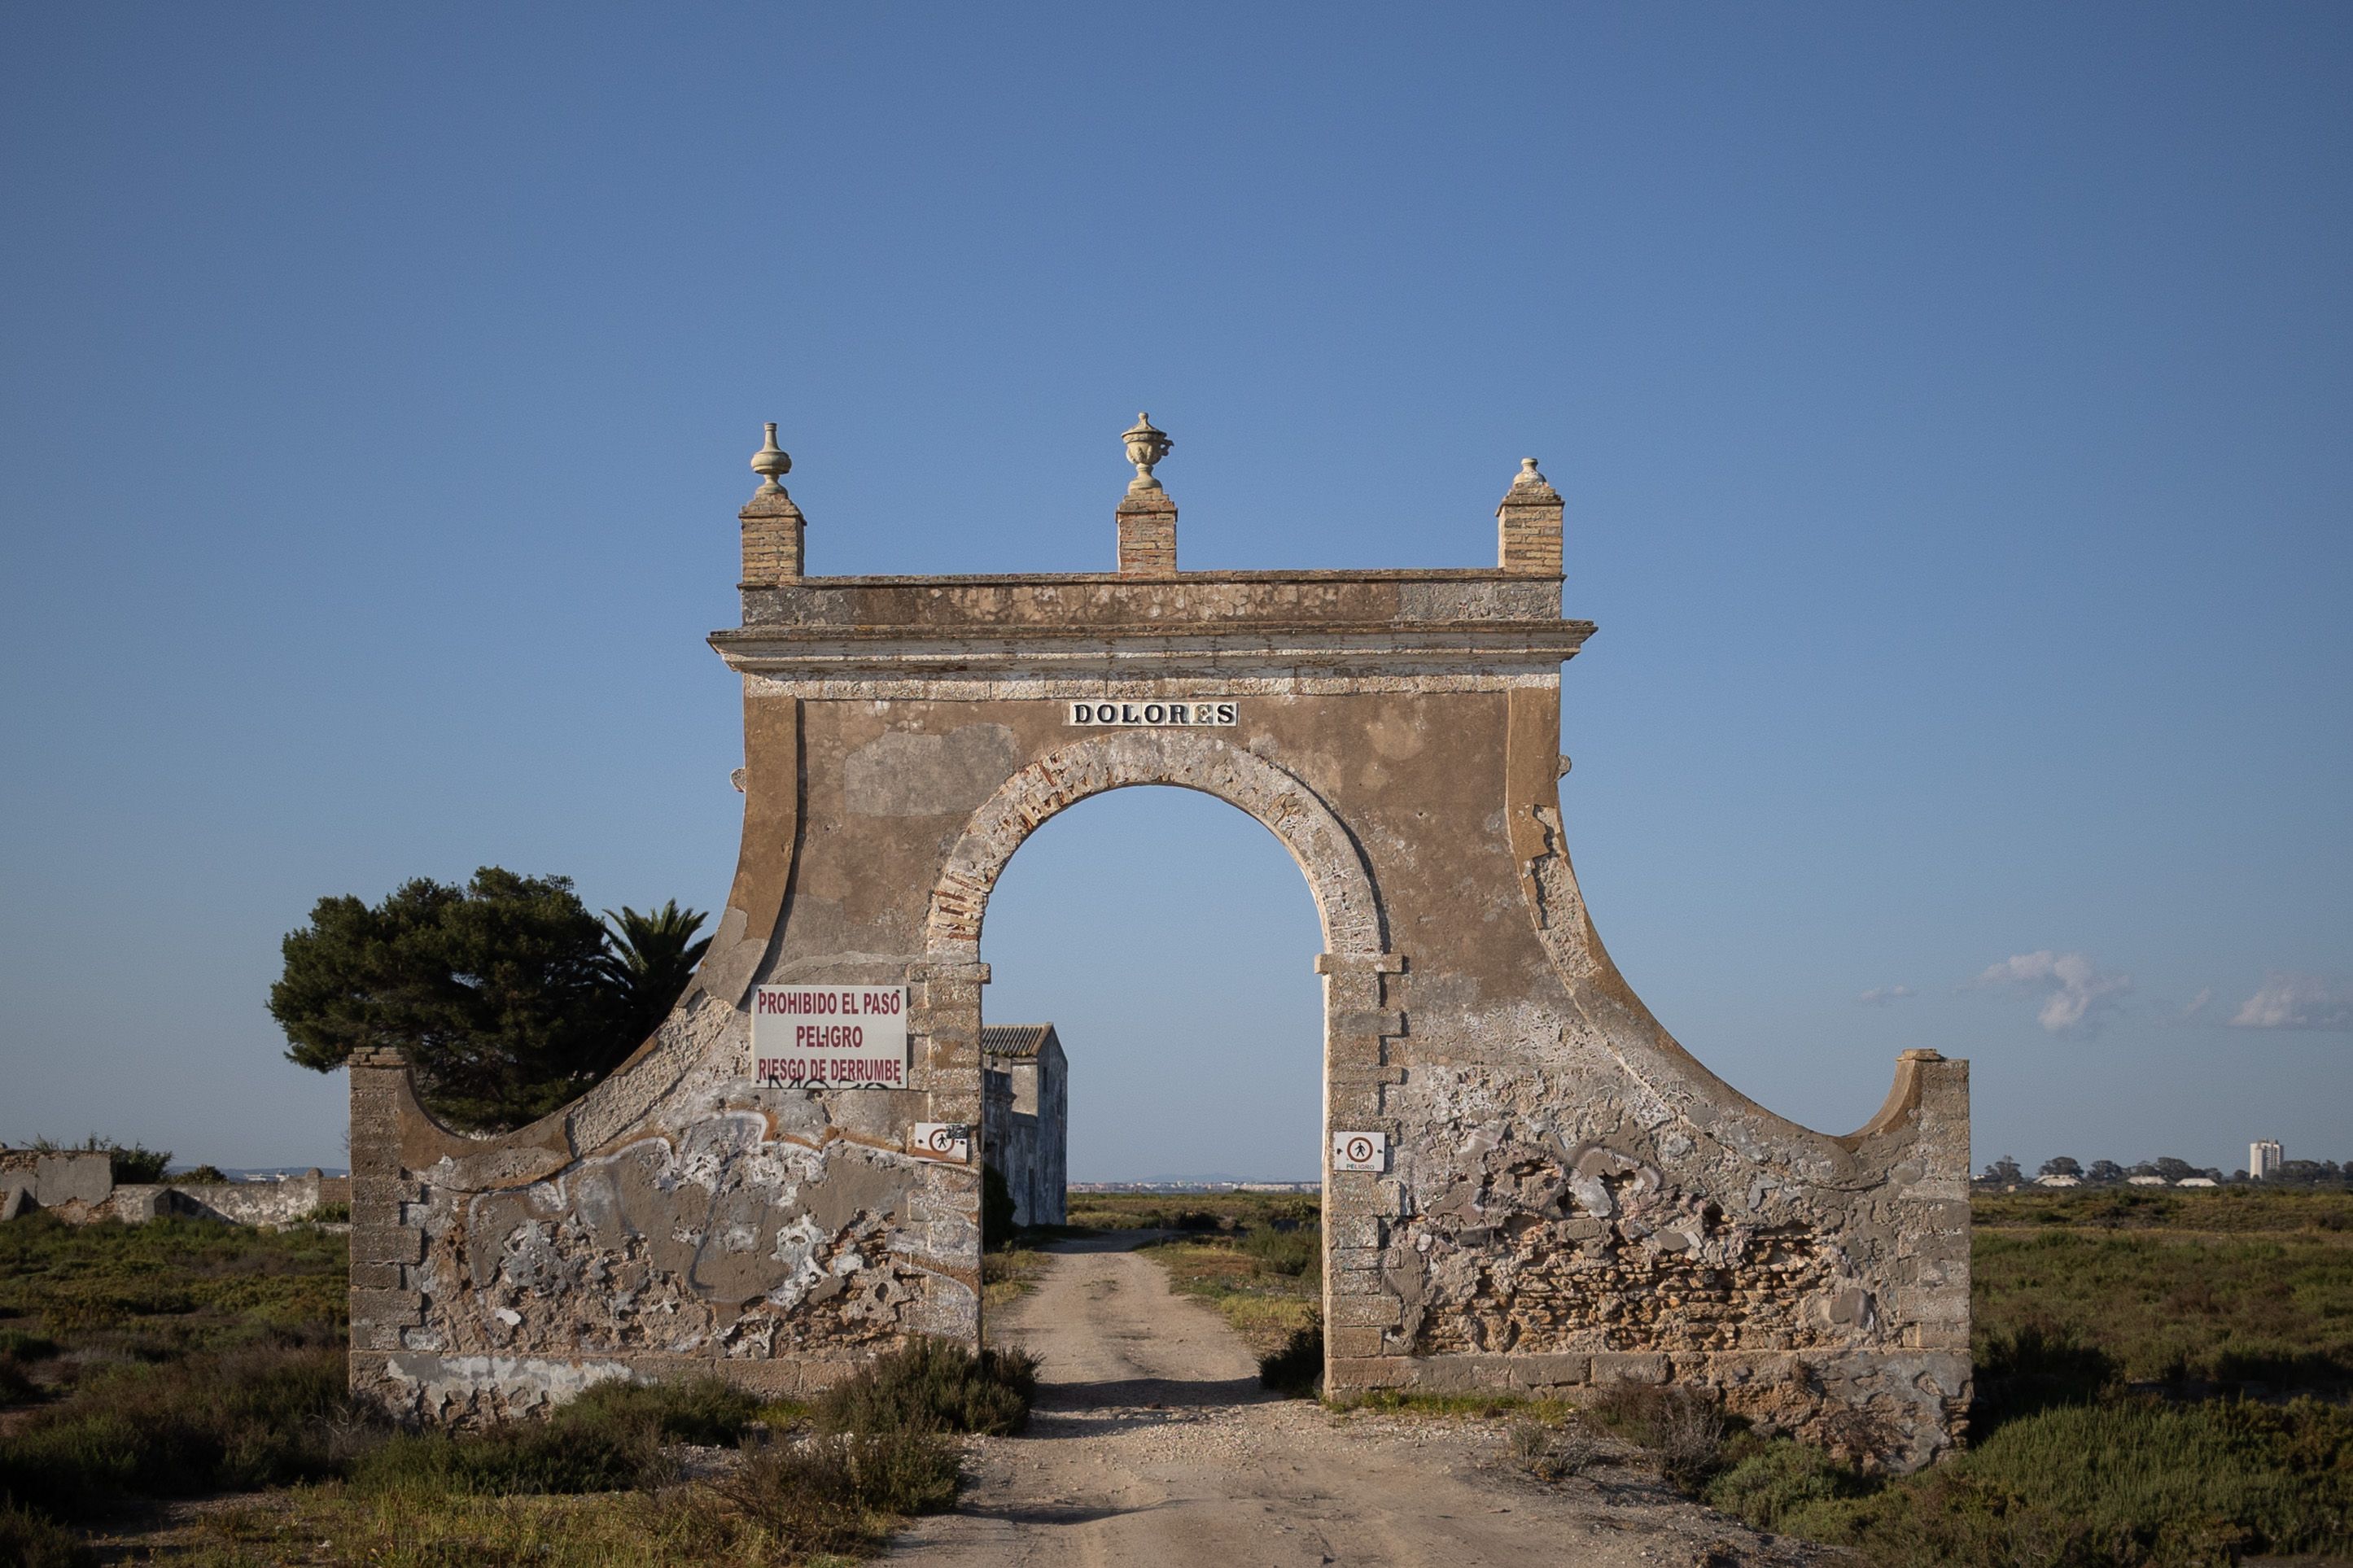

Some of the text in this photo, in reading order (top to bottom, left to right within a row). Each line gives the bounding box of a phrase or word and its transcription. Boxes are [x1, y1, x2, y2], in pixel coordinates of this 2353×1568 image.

[1074, 705, 1235, 723] DOLORES
[759, 993, 837, 1014] PROHIBIDO
[842, 993, 859, 1014] EL
[796, 1025, 863, 1047] PELIGRO
[759, 1059, 901, 1081] RIESGO DE DERRUMBE
